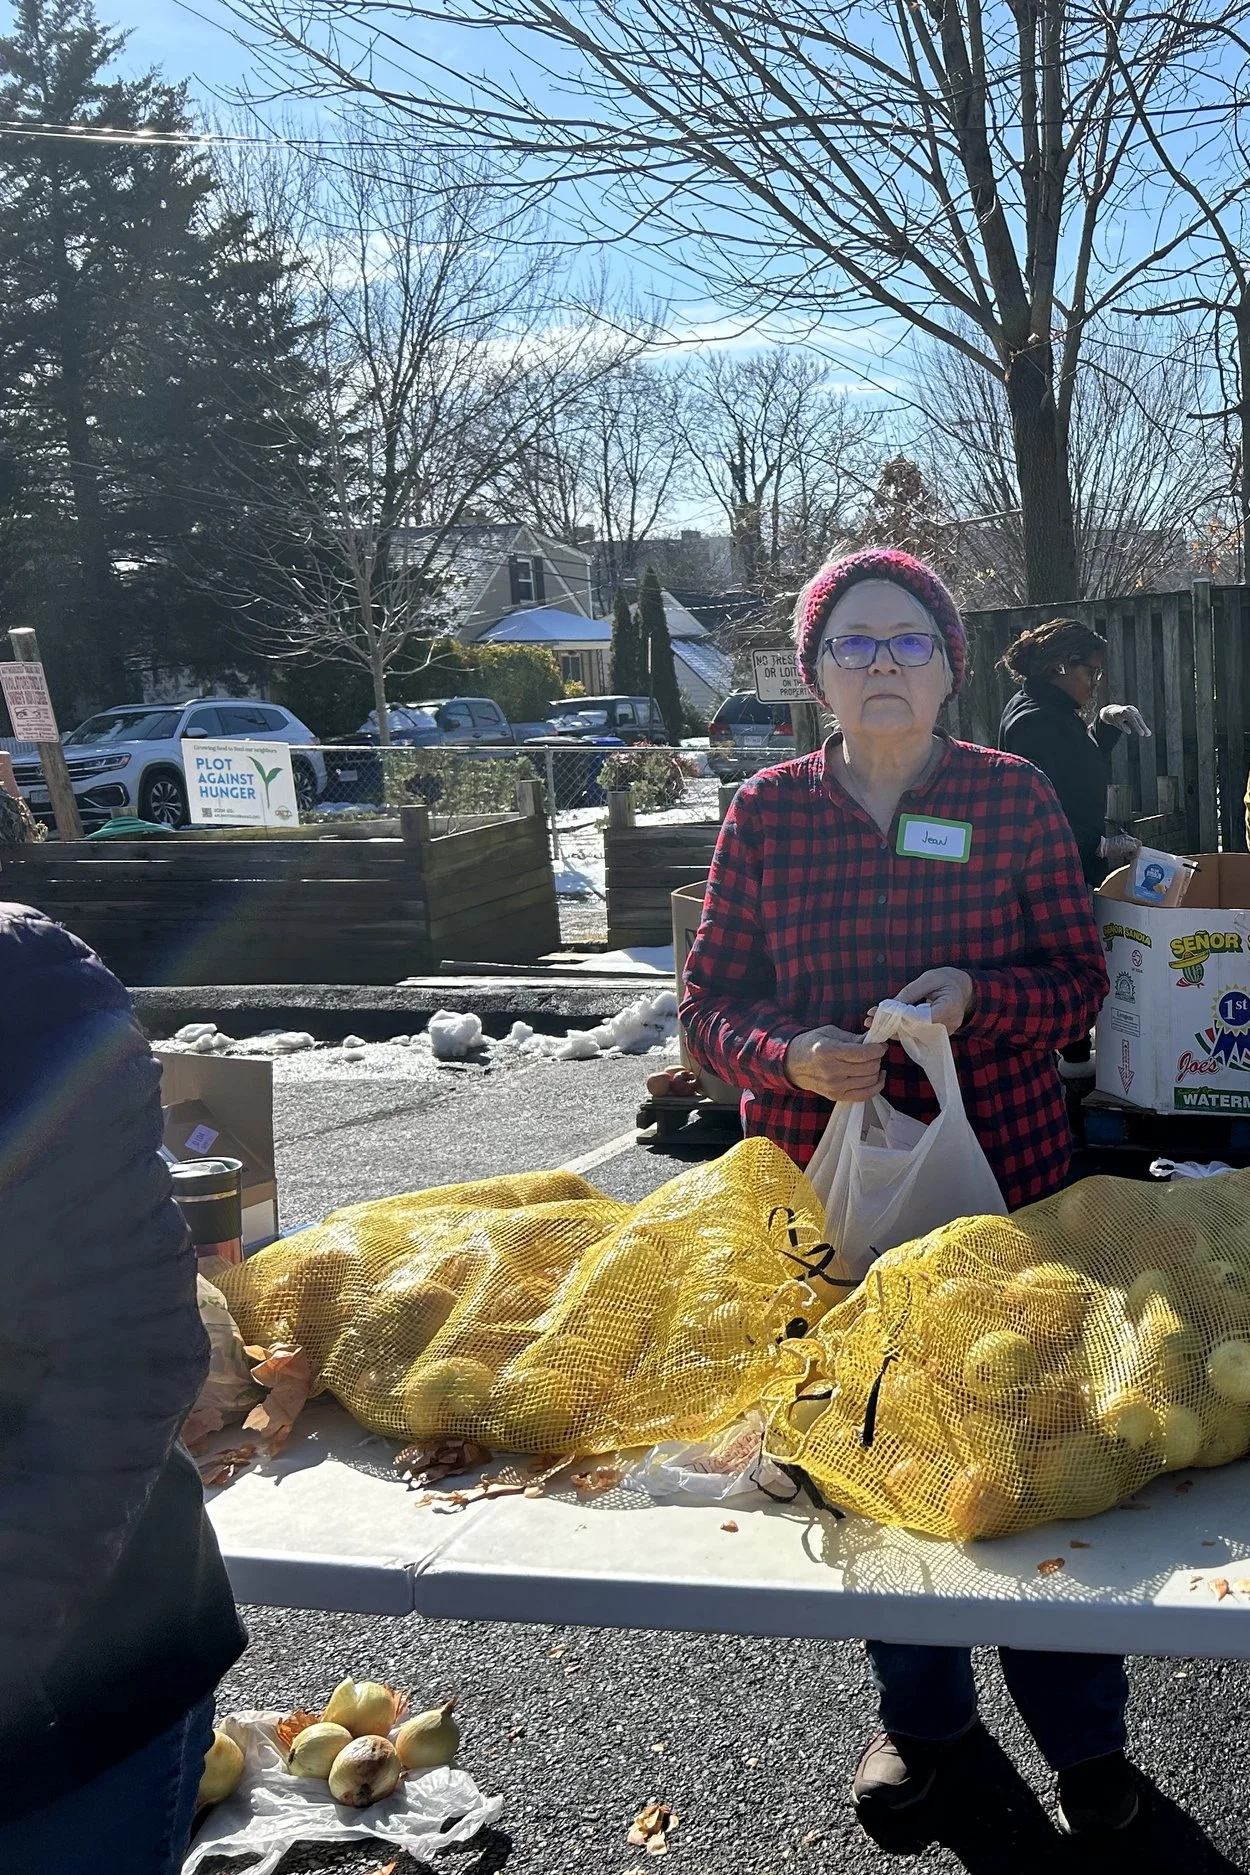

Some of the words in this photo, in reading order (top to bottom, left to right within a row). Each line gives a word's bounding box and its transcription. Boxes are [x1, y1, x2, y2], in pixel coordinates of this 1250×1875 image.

[756, 655, 768, 666] NO
[764, 668, 776, 678] OR
[780, 667, 802, 678] LOITE
[780, 688, 810, 696] PROPERT
[194, 744, 216, 752] Growing
[196, 758, 232, 770] PLOT
[198, 772, 254, 785] AGAINST
[200, 786, 256, 800] HUNGER
[1124, 926, 1152, 948] SANDIA
[1170, 930, 1242, 956] SEÑOR
[1224, 998, 1248, 1020] 1st
[1176, 1052, 1218, 1082] Joe's
